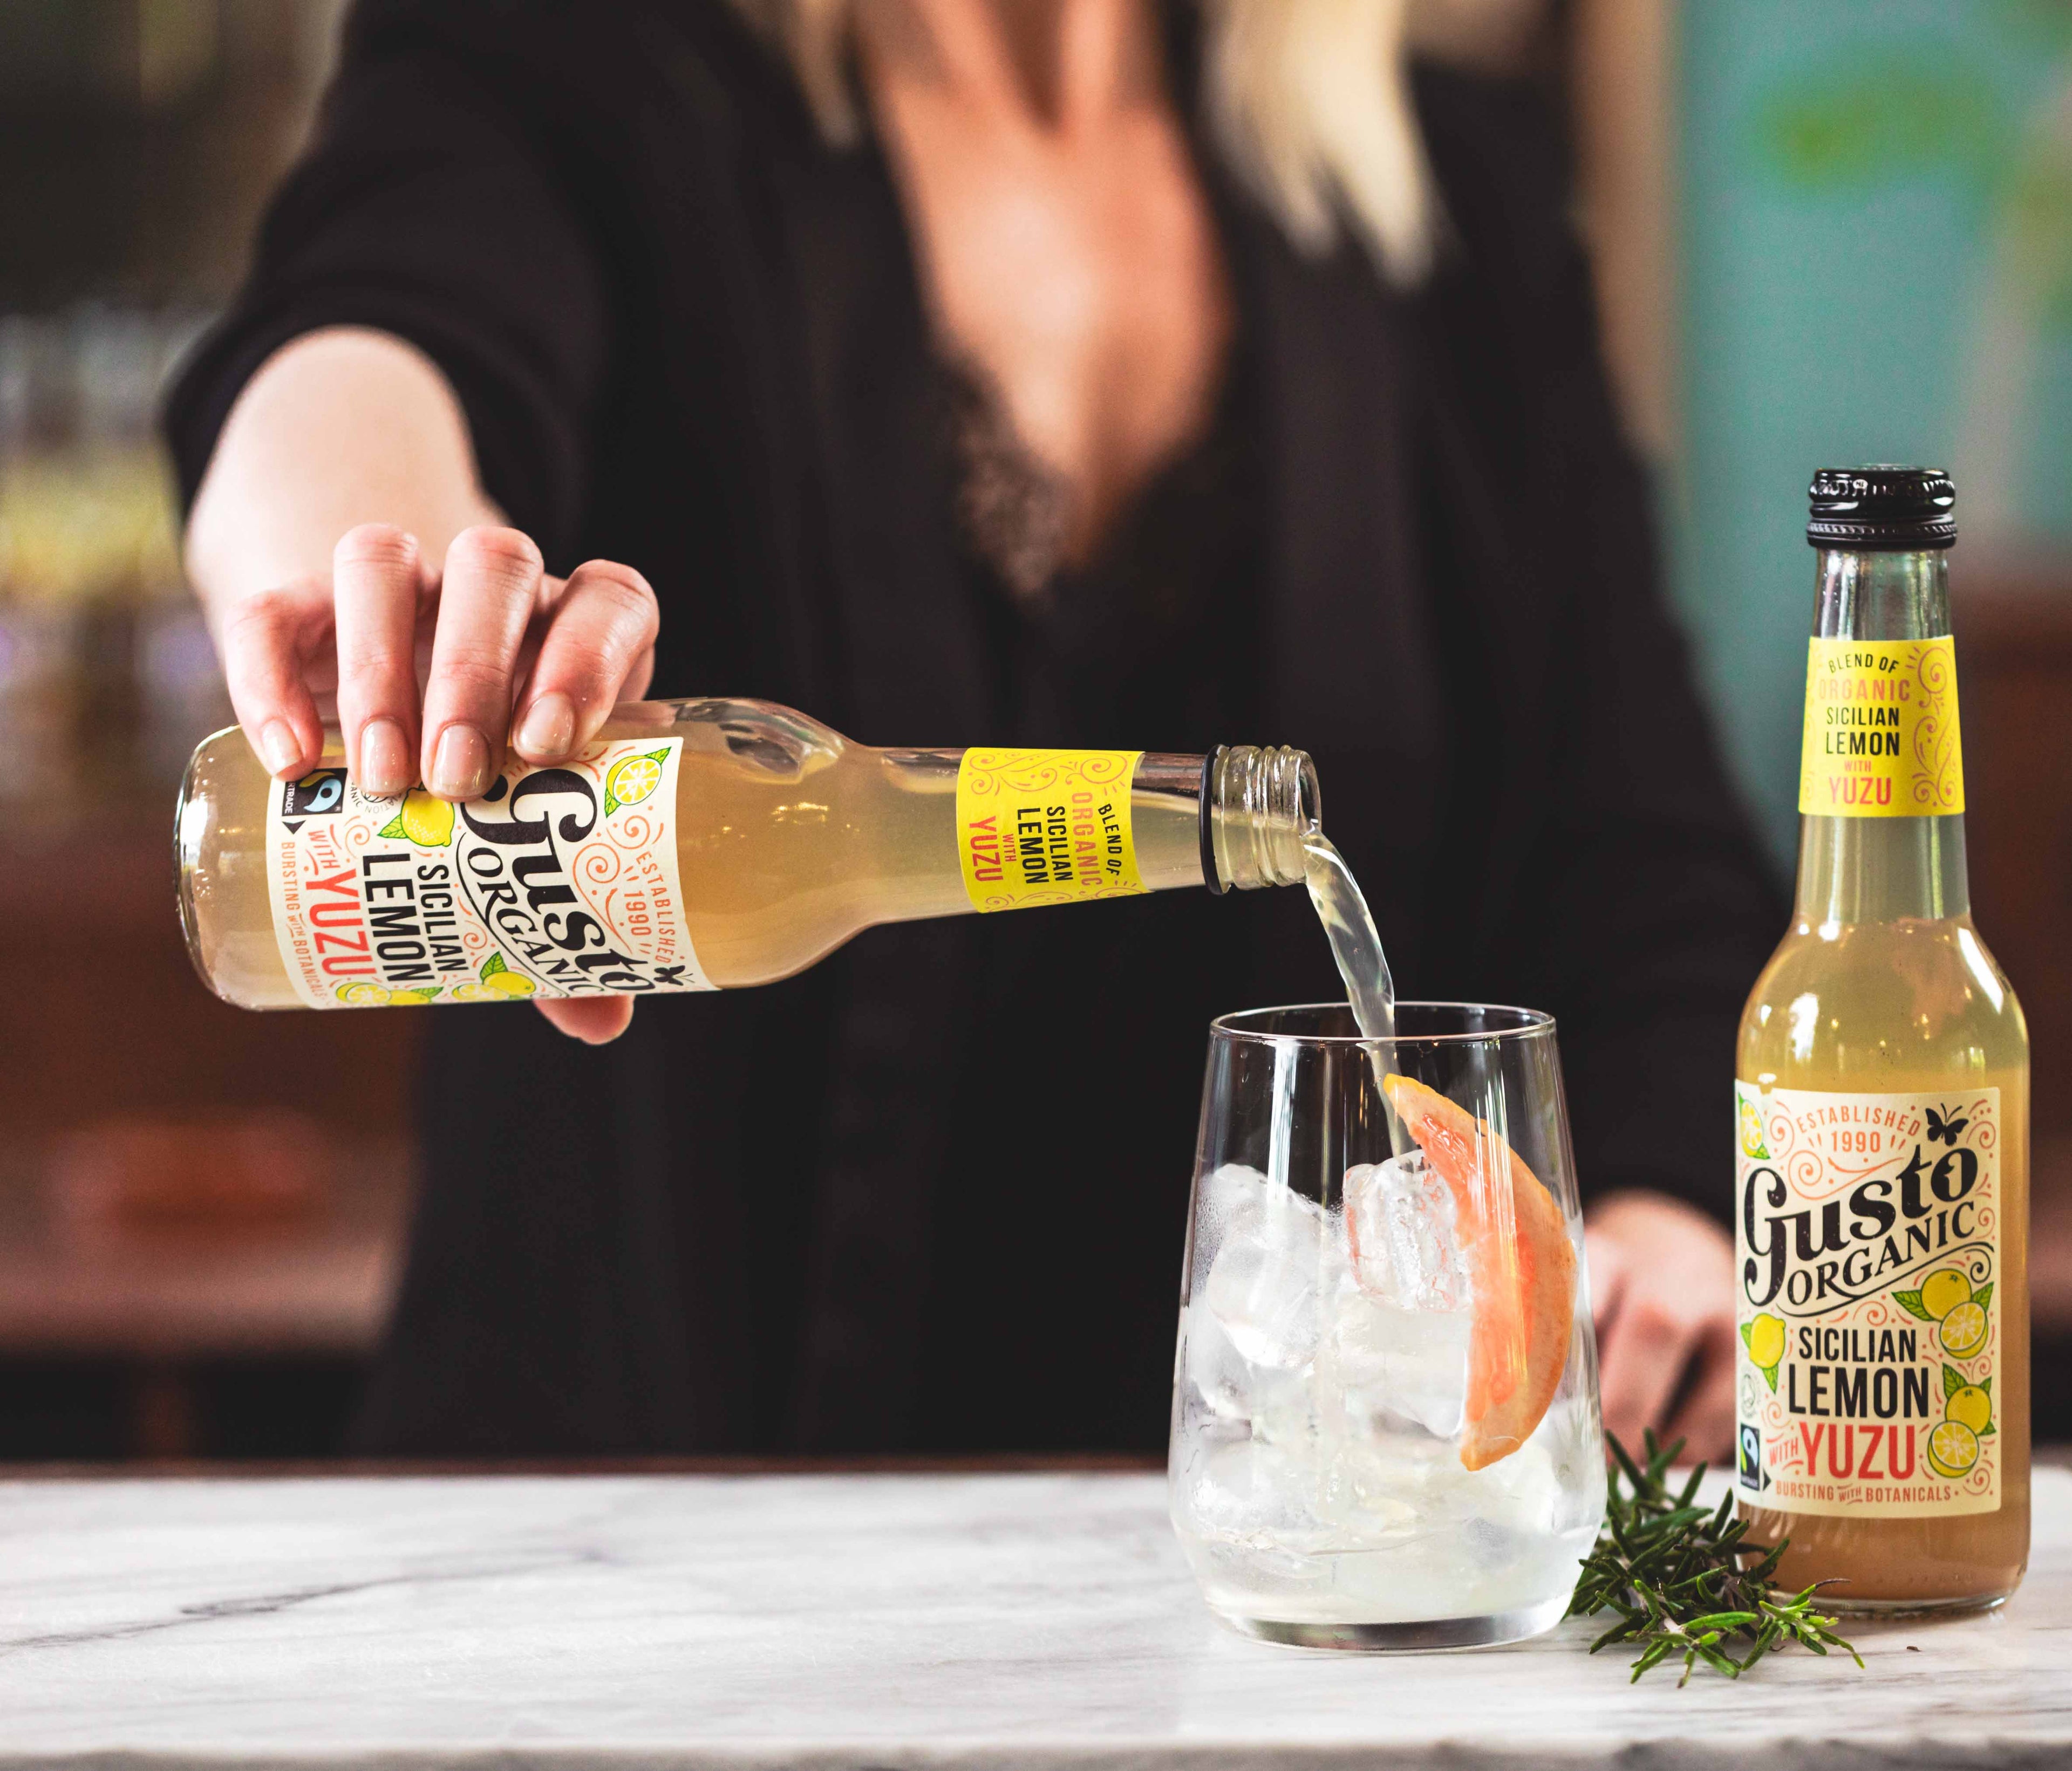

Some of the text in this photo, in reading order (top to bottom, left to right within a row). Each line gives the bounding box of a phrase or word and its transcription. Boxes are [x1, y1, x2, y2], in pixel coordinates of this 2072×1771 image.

[1819, 679, 1910, 701] ORGANIC
[1829, 654, 1899, 673] BLEND OF
[1826, 707, 1899, 726] SICILIAN
[1826, 731, 1900, 756] LEMON
[1829, 777, 1892, 805] YUZU
[1844, 761, 1872, 772] WITH
[969, 816, 1004, 882] YUZU
[1002, 833, 1017, 863] WITH
[1017, 808, 1049, 884] LEMON
[1047, 806, 1074, 881] SICILIAN
[1072, 792, 1103, 886] ORGANIC
[1098, 803, 1122, 876] BLEND OF
[281, 842, 301, 911] BURSTING
[305, 830, 377, 975] WITH YUZU
[460, 768, 656, 990] Gusto
[287, 915, 306, 937] WITH
[362, 853, 435, 983] LEMON
[417, 864, 468, 972] SICILIAN
[467, 846, 604, 992] ORGANIC
[624, 889, 652, 936] 1990
[636, 851, 676, 963] ESTABLISHED
[1797, 1105, 1920, 1137] ESTABLISHED
[1831, 1131, 1881, 1153] 1990
[1743, 1144, 1978, 1307] Gusto
[1787, 1201, 1976, 1306] ORGANIC
[1798, 1326, 1917, 1363] SICILIAN
[1788, 1364, 1929, 1418] LEMON
[1769, 1421, 1916, 1480] WITH YUZU
[1775, 1480, 1834, 1501] BURSTING
[1838, 1486, 1862, 1502] WITH
[1865, 1485, 1951, 1502] BOTANICALS
